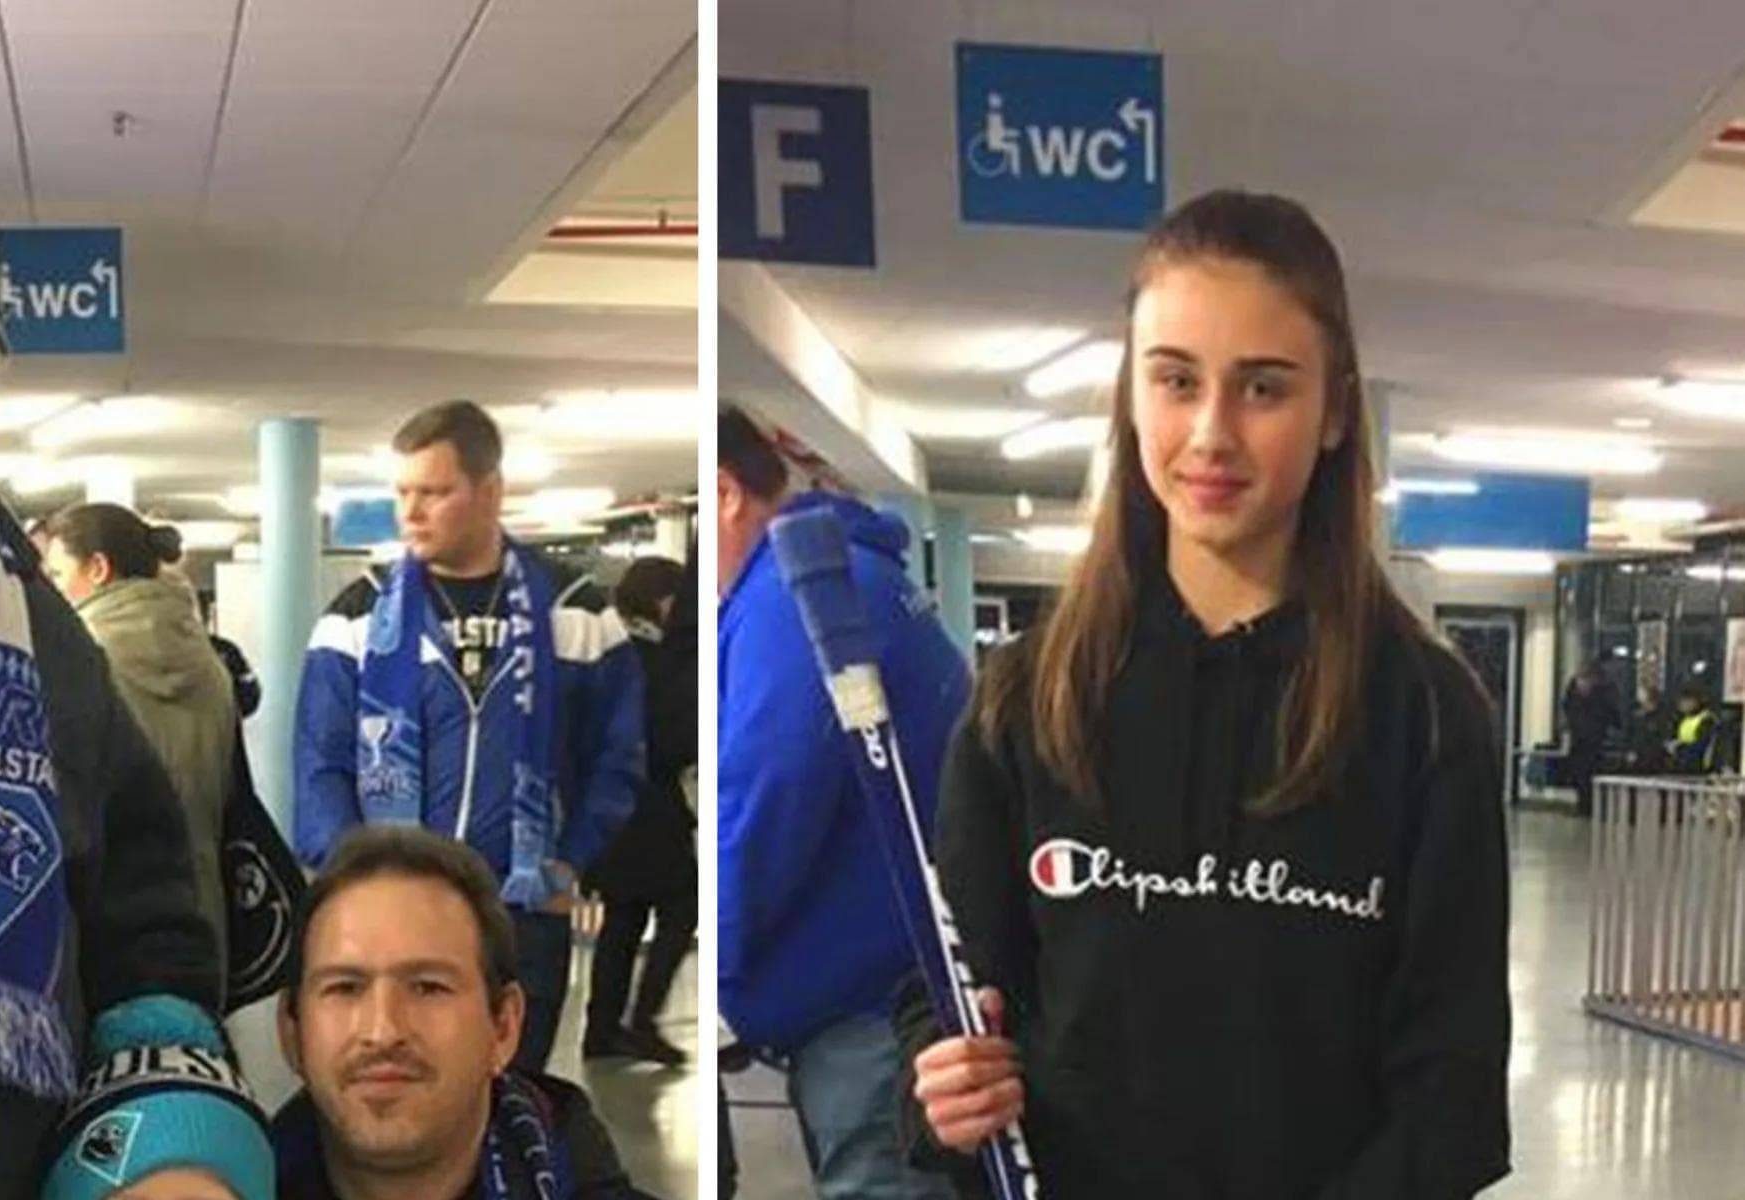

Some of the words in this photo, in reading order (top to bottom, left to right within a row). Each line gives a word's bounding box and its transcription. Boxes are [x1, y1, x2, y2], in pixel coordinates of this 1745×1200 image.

[750, 105, 822, 239] F
[1026, 126, 1127, 181] WC
[28, 281, 97, 318] WC
